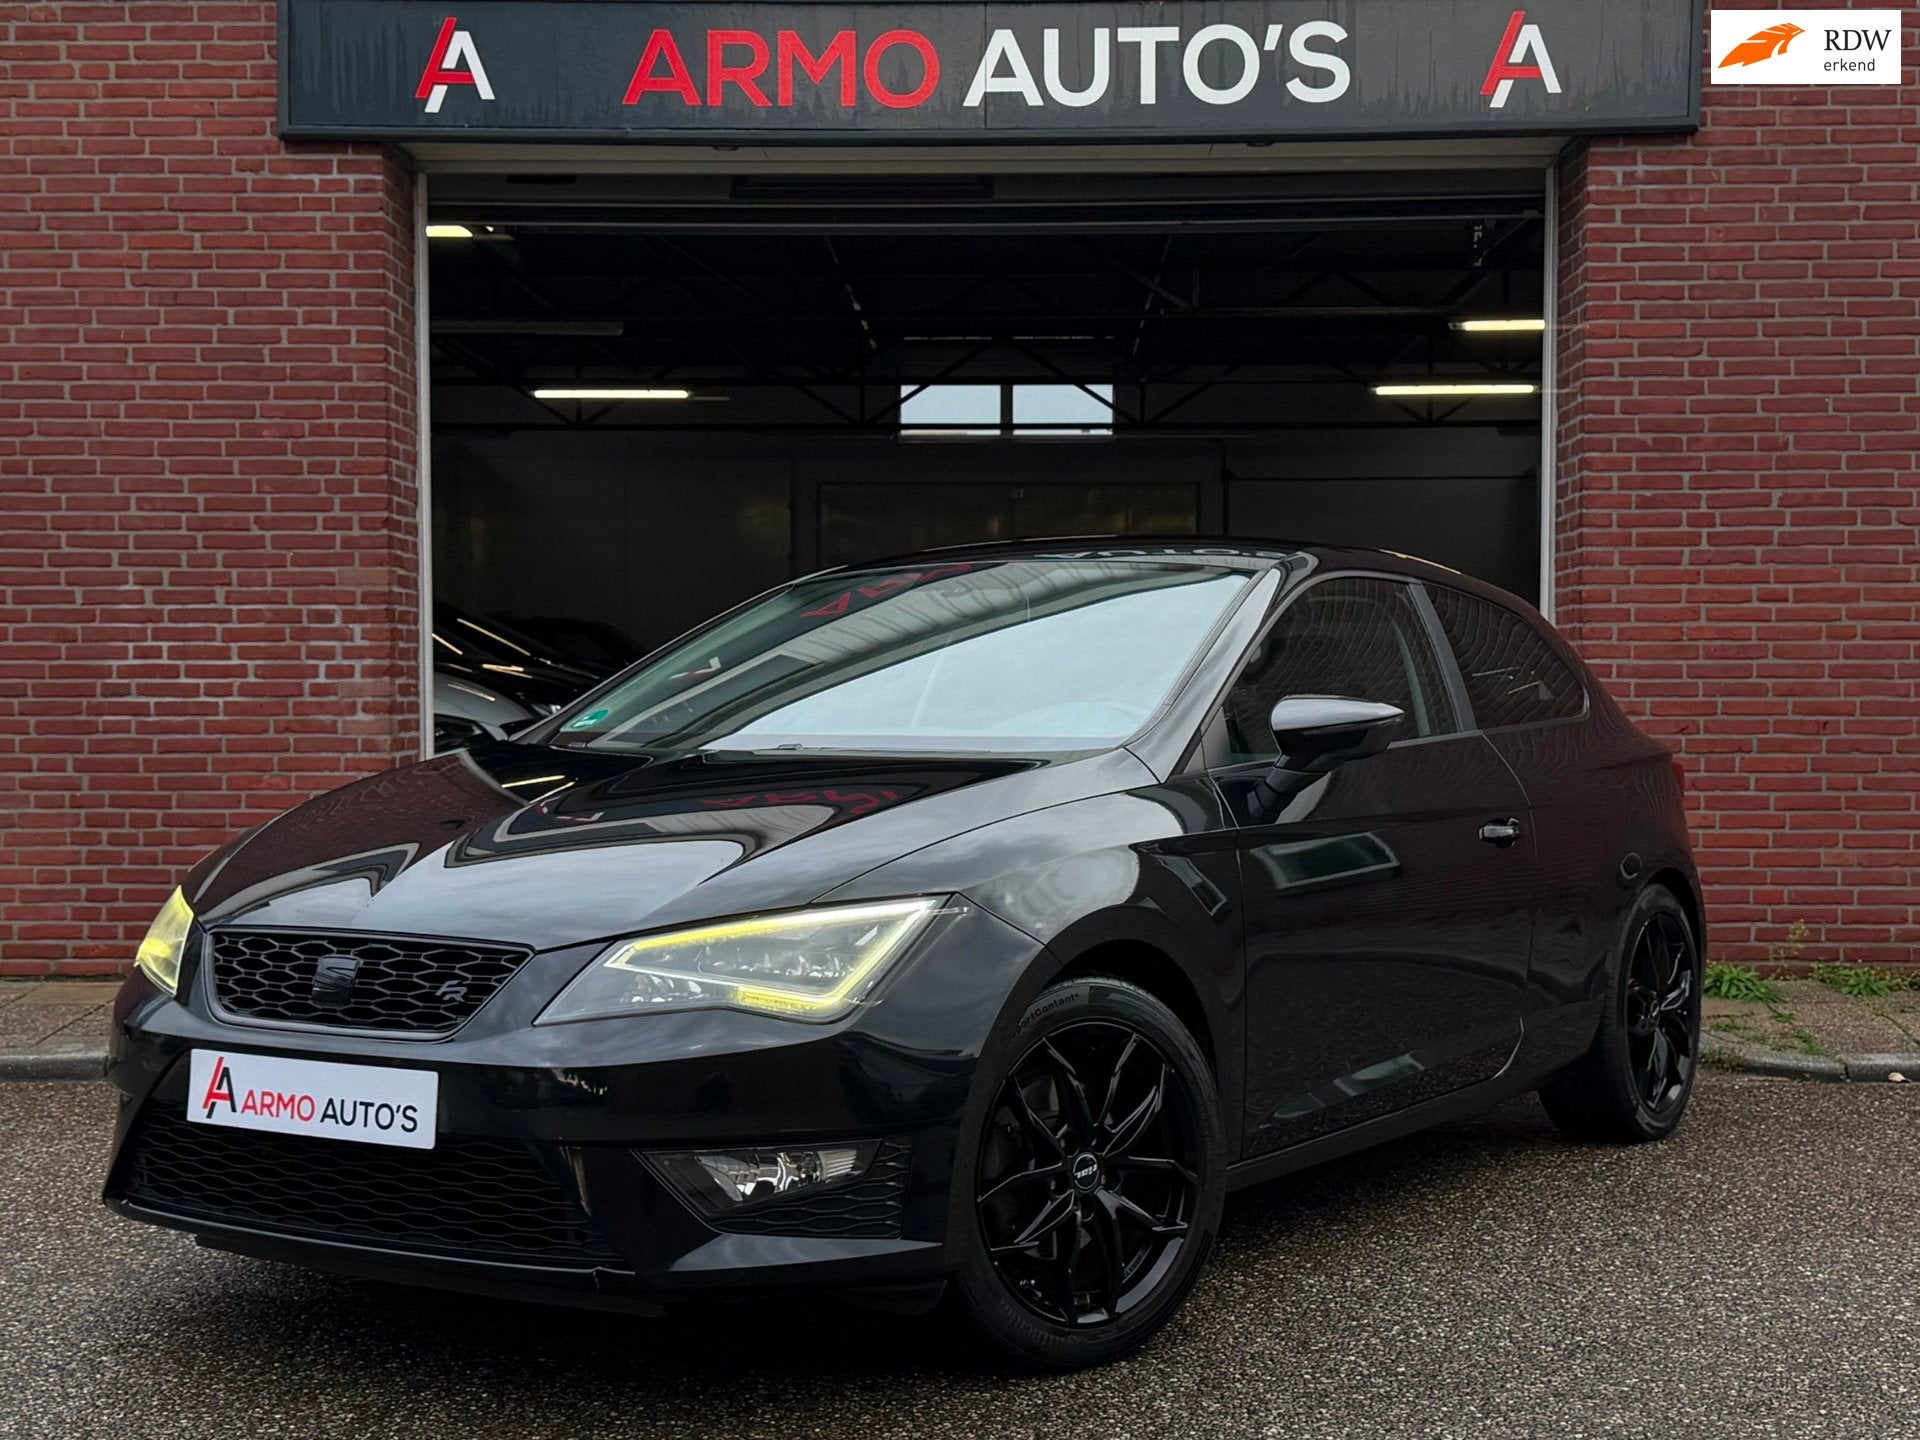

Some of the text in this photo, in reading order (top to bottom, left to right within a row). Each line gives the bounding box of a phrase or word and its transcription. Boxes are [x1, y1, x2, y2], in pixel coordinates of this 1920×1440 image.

[622, 20, 1351, 108] ARMO AUTO'S
[240, 1089, 418, 1133] ARMO AUTO'S
